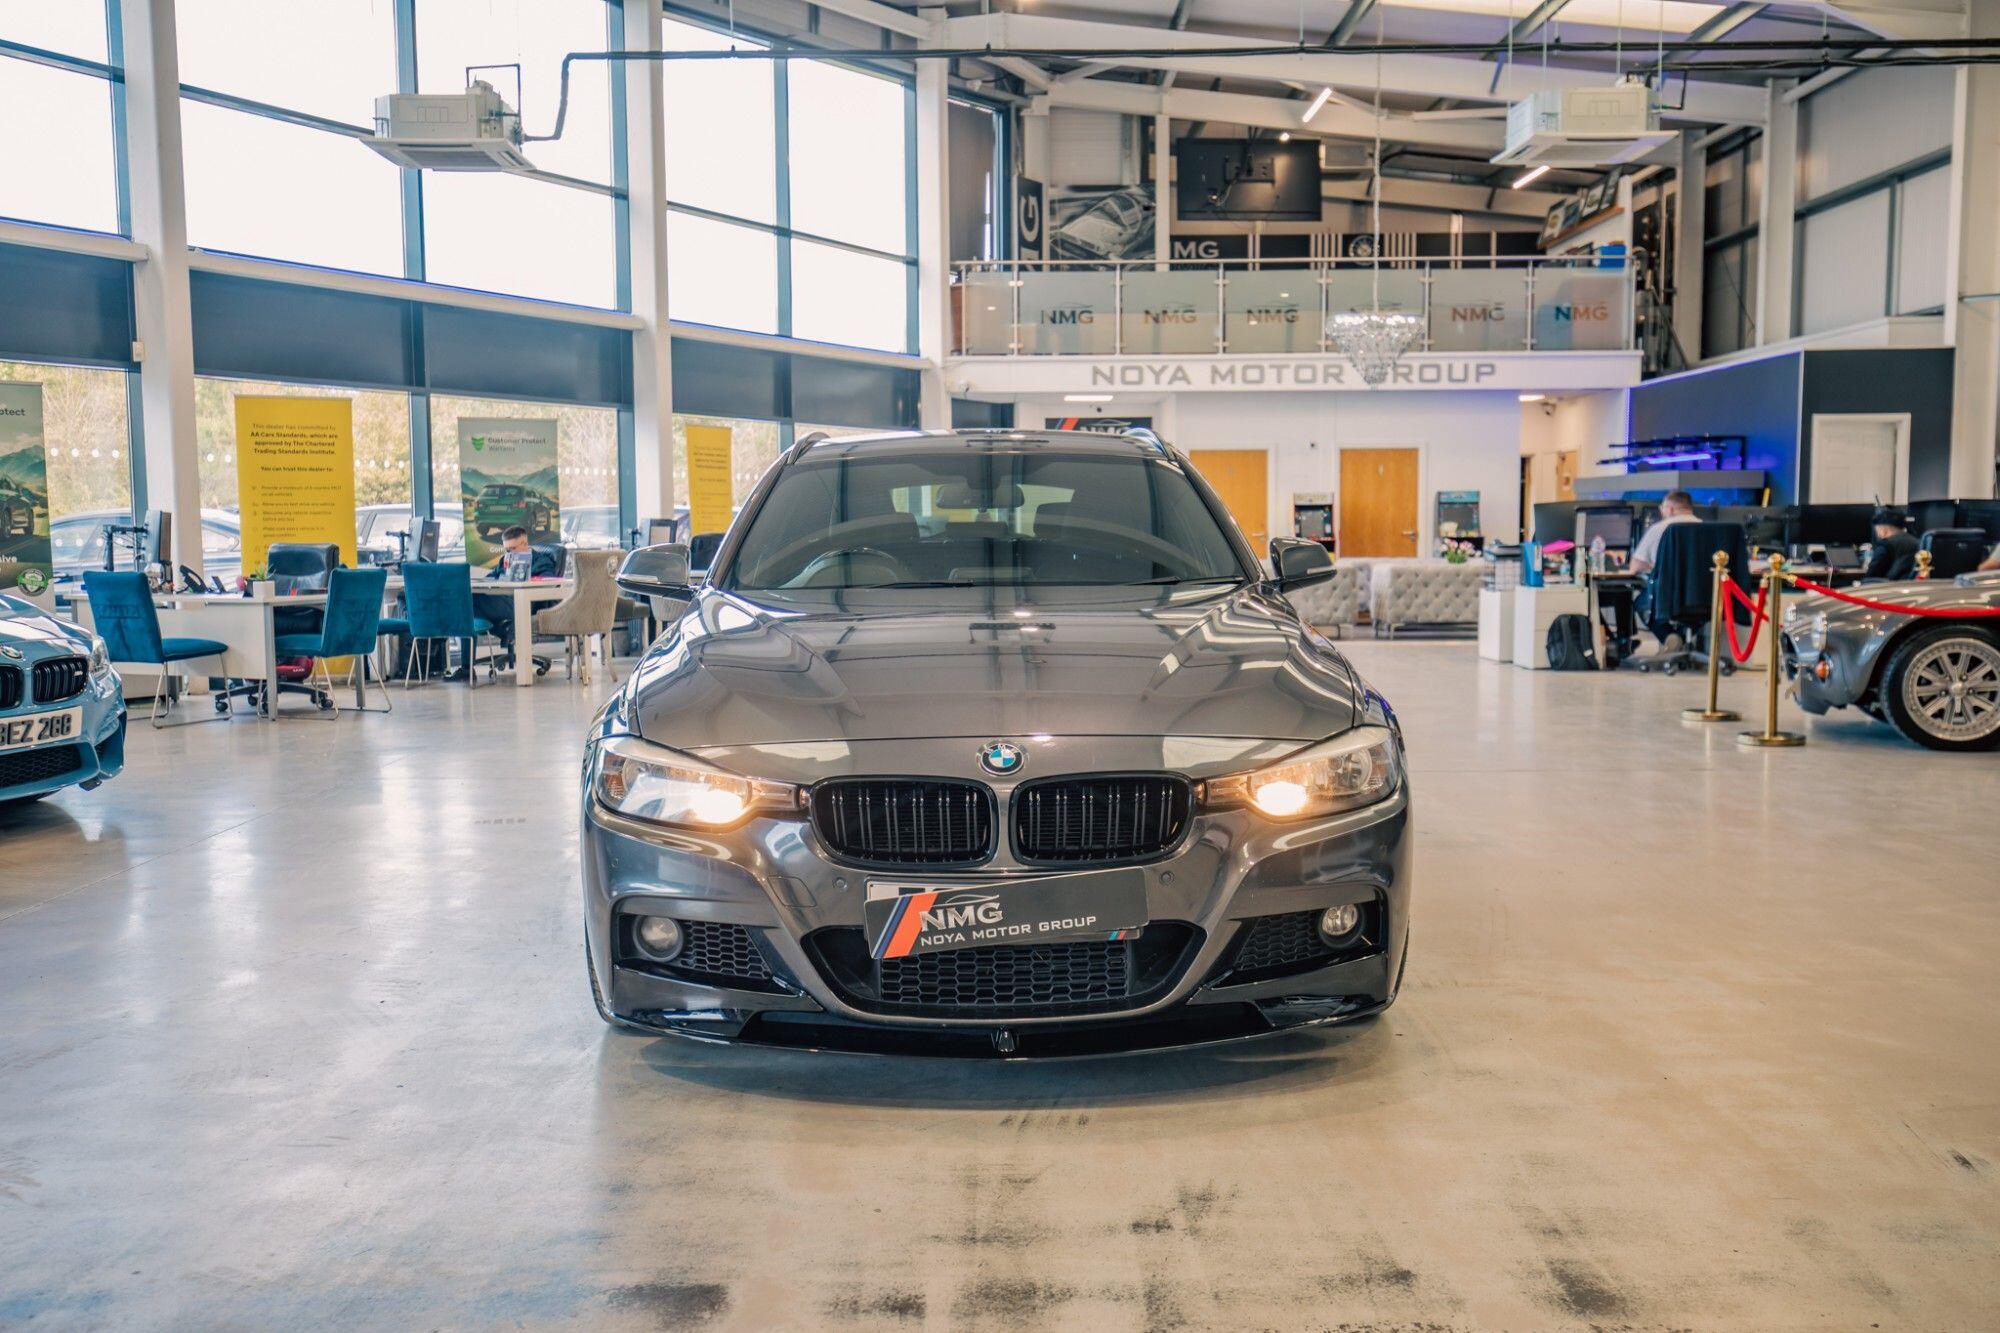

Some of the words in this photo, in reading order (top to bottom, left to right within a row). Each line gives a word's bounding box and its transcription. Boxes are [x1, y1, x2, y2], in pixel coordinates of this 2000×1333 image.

[1041, 309, 1094, 325] NMG
[1145, 309, 1197, 324] NMG
[1247, 308, 1300, 323] NMG
[1452, 306, 1505, 322] NMG
[1554, 305, 1609, 321] NMG
[1092, 364, 1192, 386] NOYA
[1211, 364, 1345, 385] MOTOR
[919, 902, 1003, 933] NMG
[920, 932, 965, 947] NOYA
[972, 924, 1031, 940] MOTOR
[1038, 915, 1097, 932] GROUP
